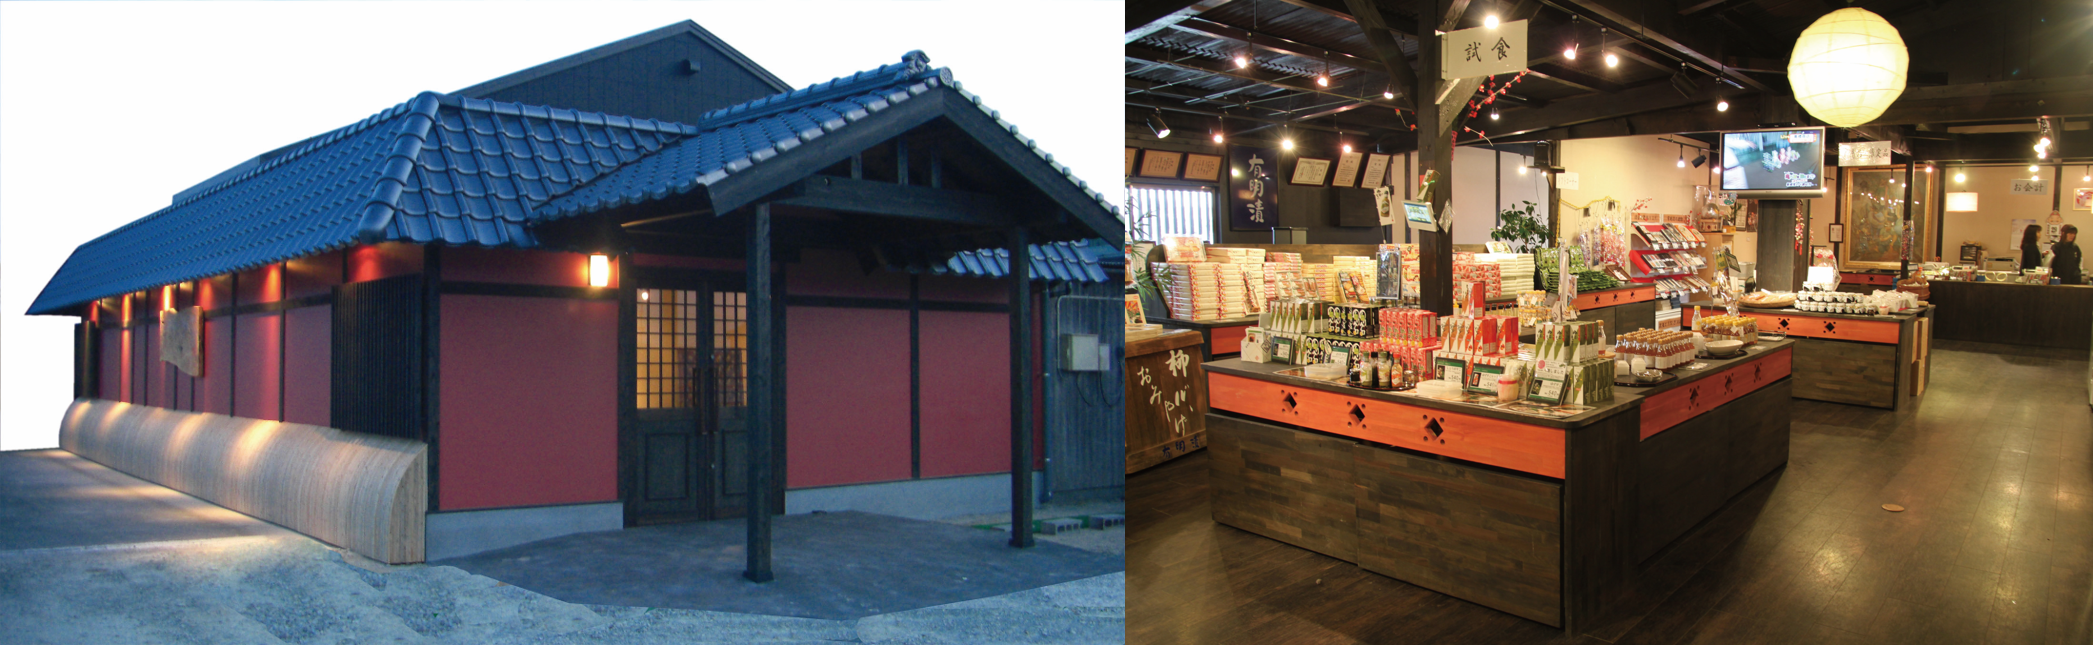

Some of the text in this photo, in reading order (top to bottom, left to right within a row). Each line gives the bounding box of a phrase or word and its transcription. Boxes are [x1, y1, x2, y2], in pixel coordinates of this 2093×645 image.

[1464, 36, 1511, 63] 試食
[1246, 153, 1265, 223] 有明漬
[2013, 182, 2044, 193] お会計
